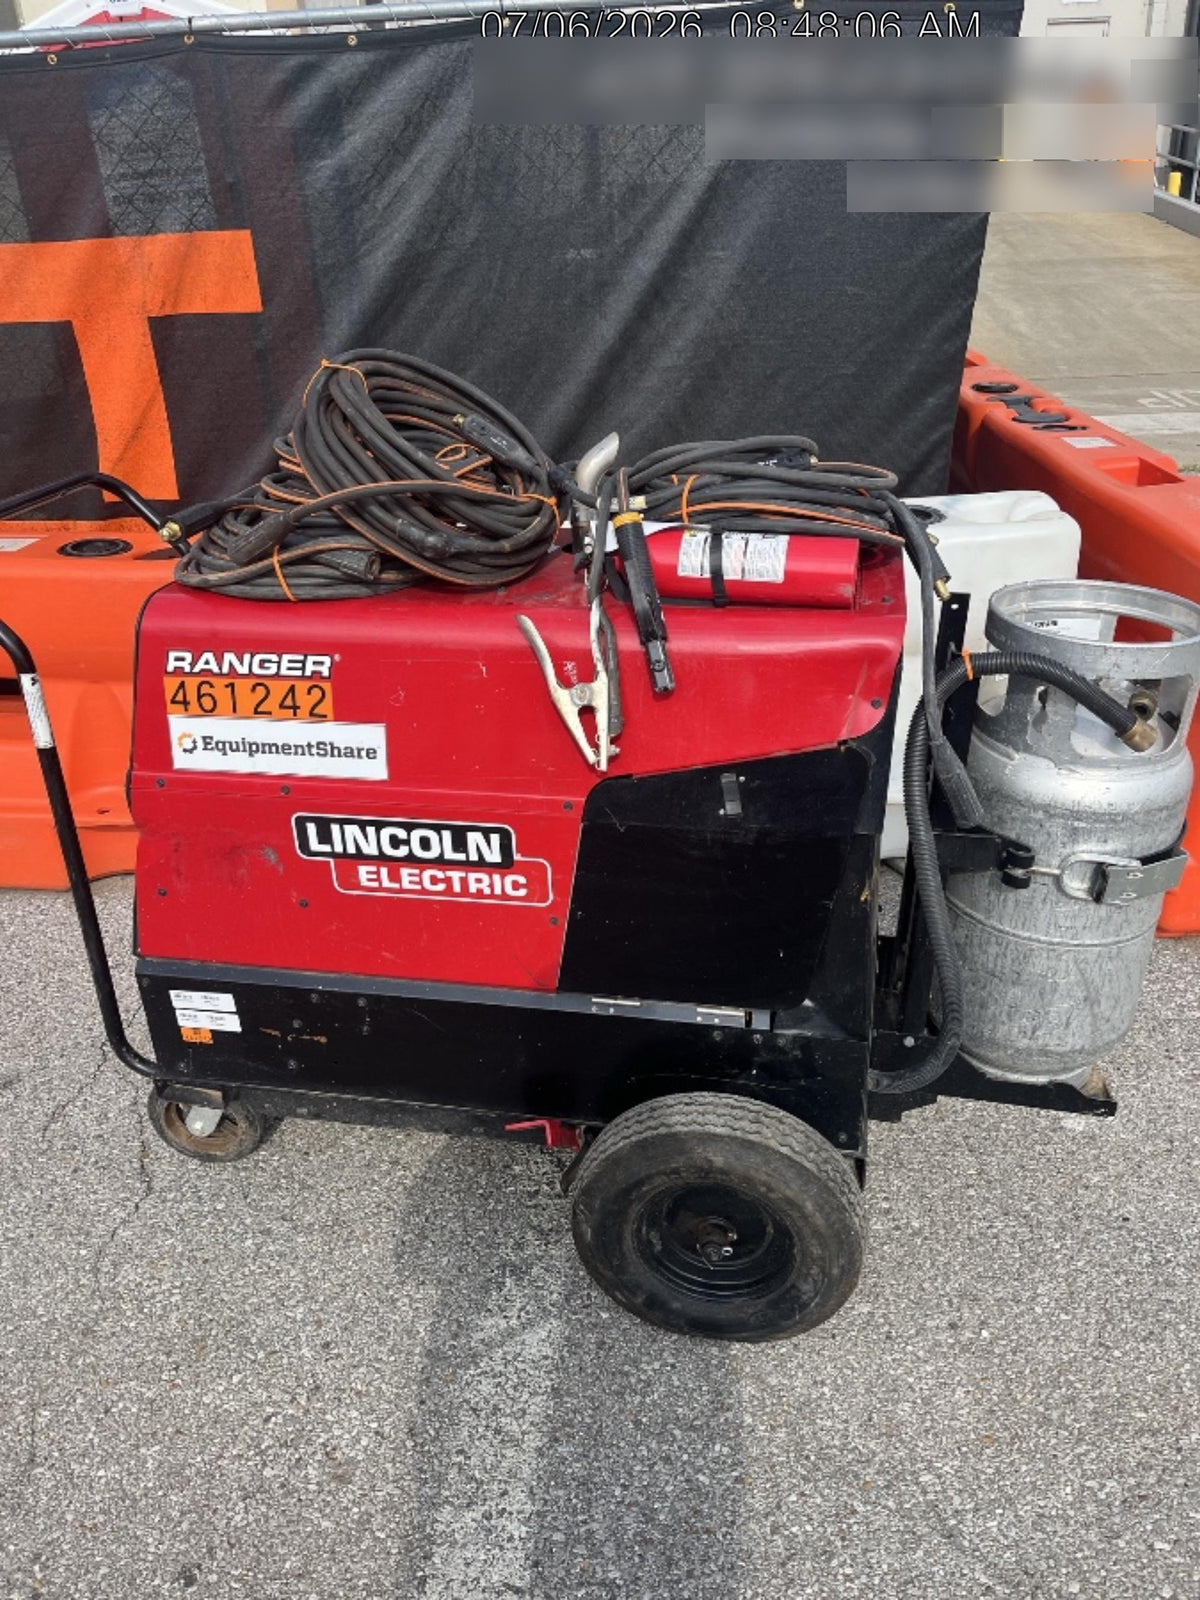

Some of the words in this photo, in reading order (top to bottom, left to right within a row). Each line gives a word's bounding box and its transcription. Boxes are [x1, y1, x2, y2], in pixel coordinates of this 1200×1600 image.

[169, 679, 328, 719] 461242
[201, 736, 378, 759] EquipmentShare
[305, 821, 503, 864] LINCOLN
[357, 865, 529, 898] ELECTRIC
